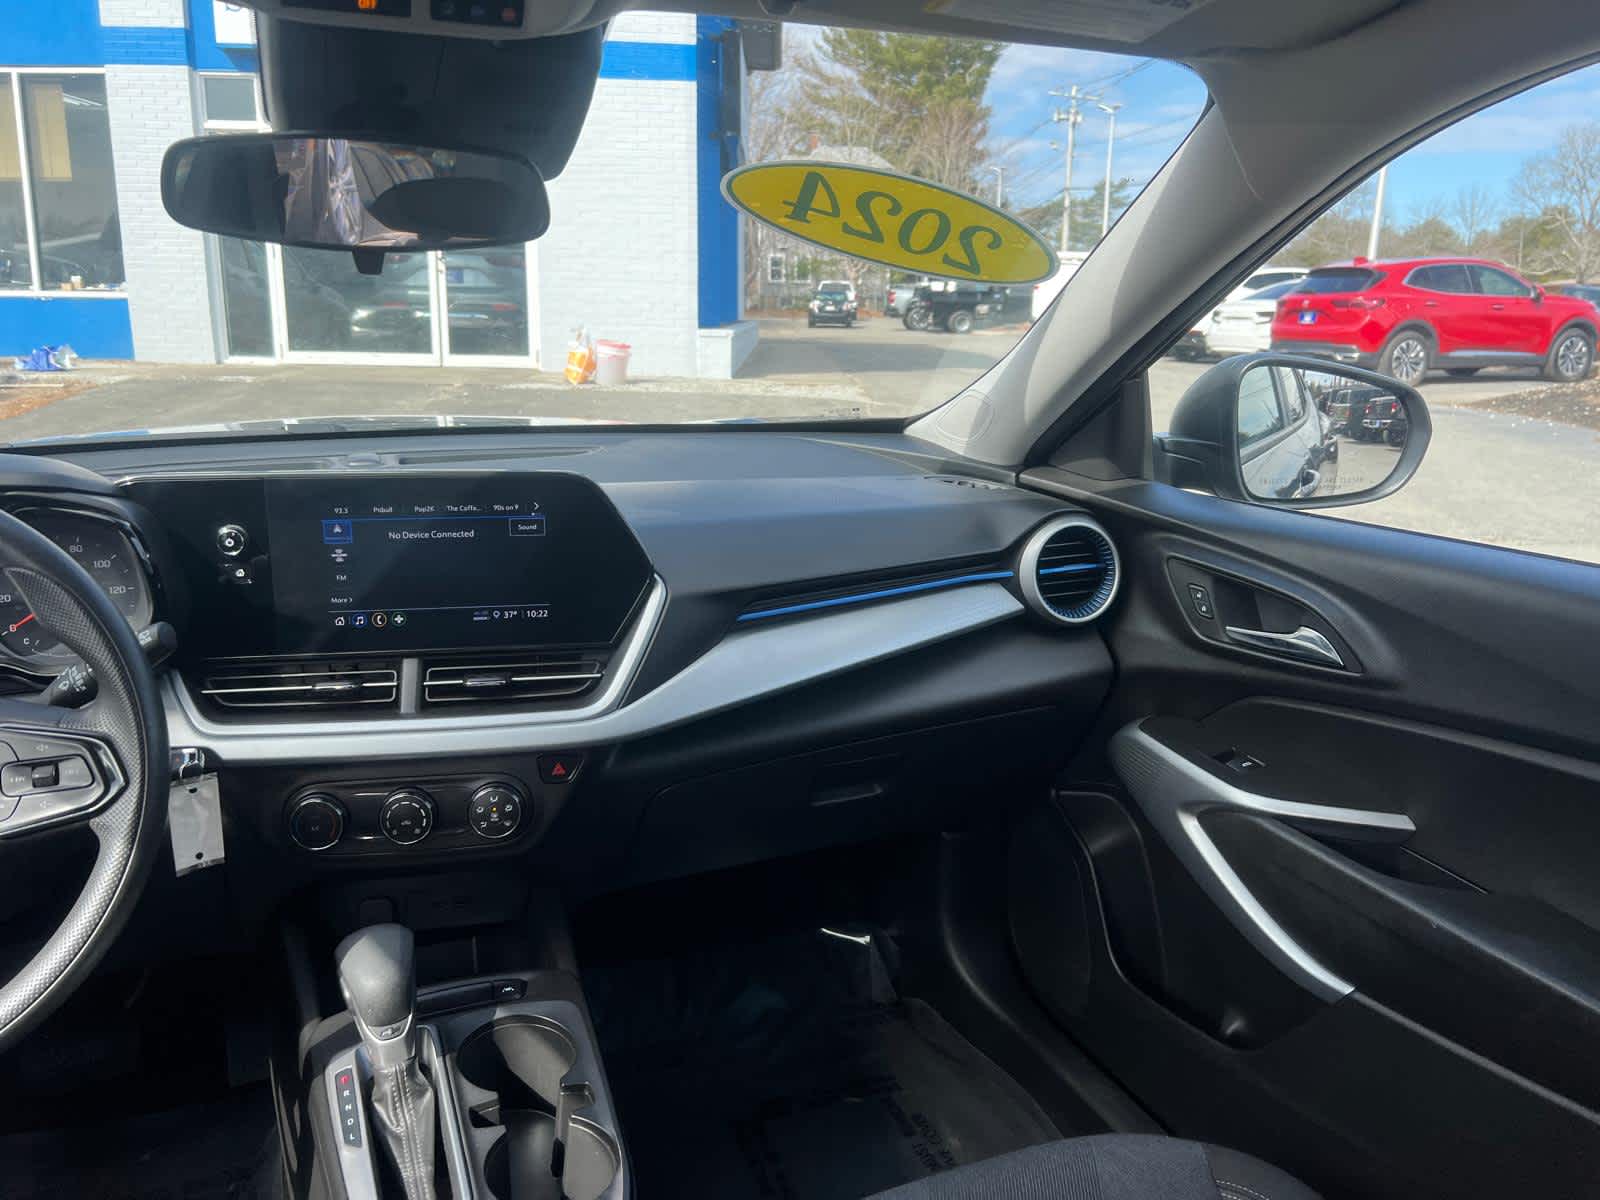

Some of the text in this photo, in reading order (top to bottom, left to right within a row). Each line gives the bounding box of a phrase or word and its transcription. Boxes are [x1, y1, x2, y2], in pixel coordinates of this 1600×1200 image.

[388, 529, 475, 539] No Device Connected
[93, 560, 111, 568] 100
[109, 585, 126, 594] 120
[503, 610, 518, 619] 37°
[527, 609, 548, 618] 10:22
